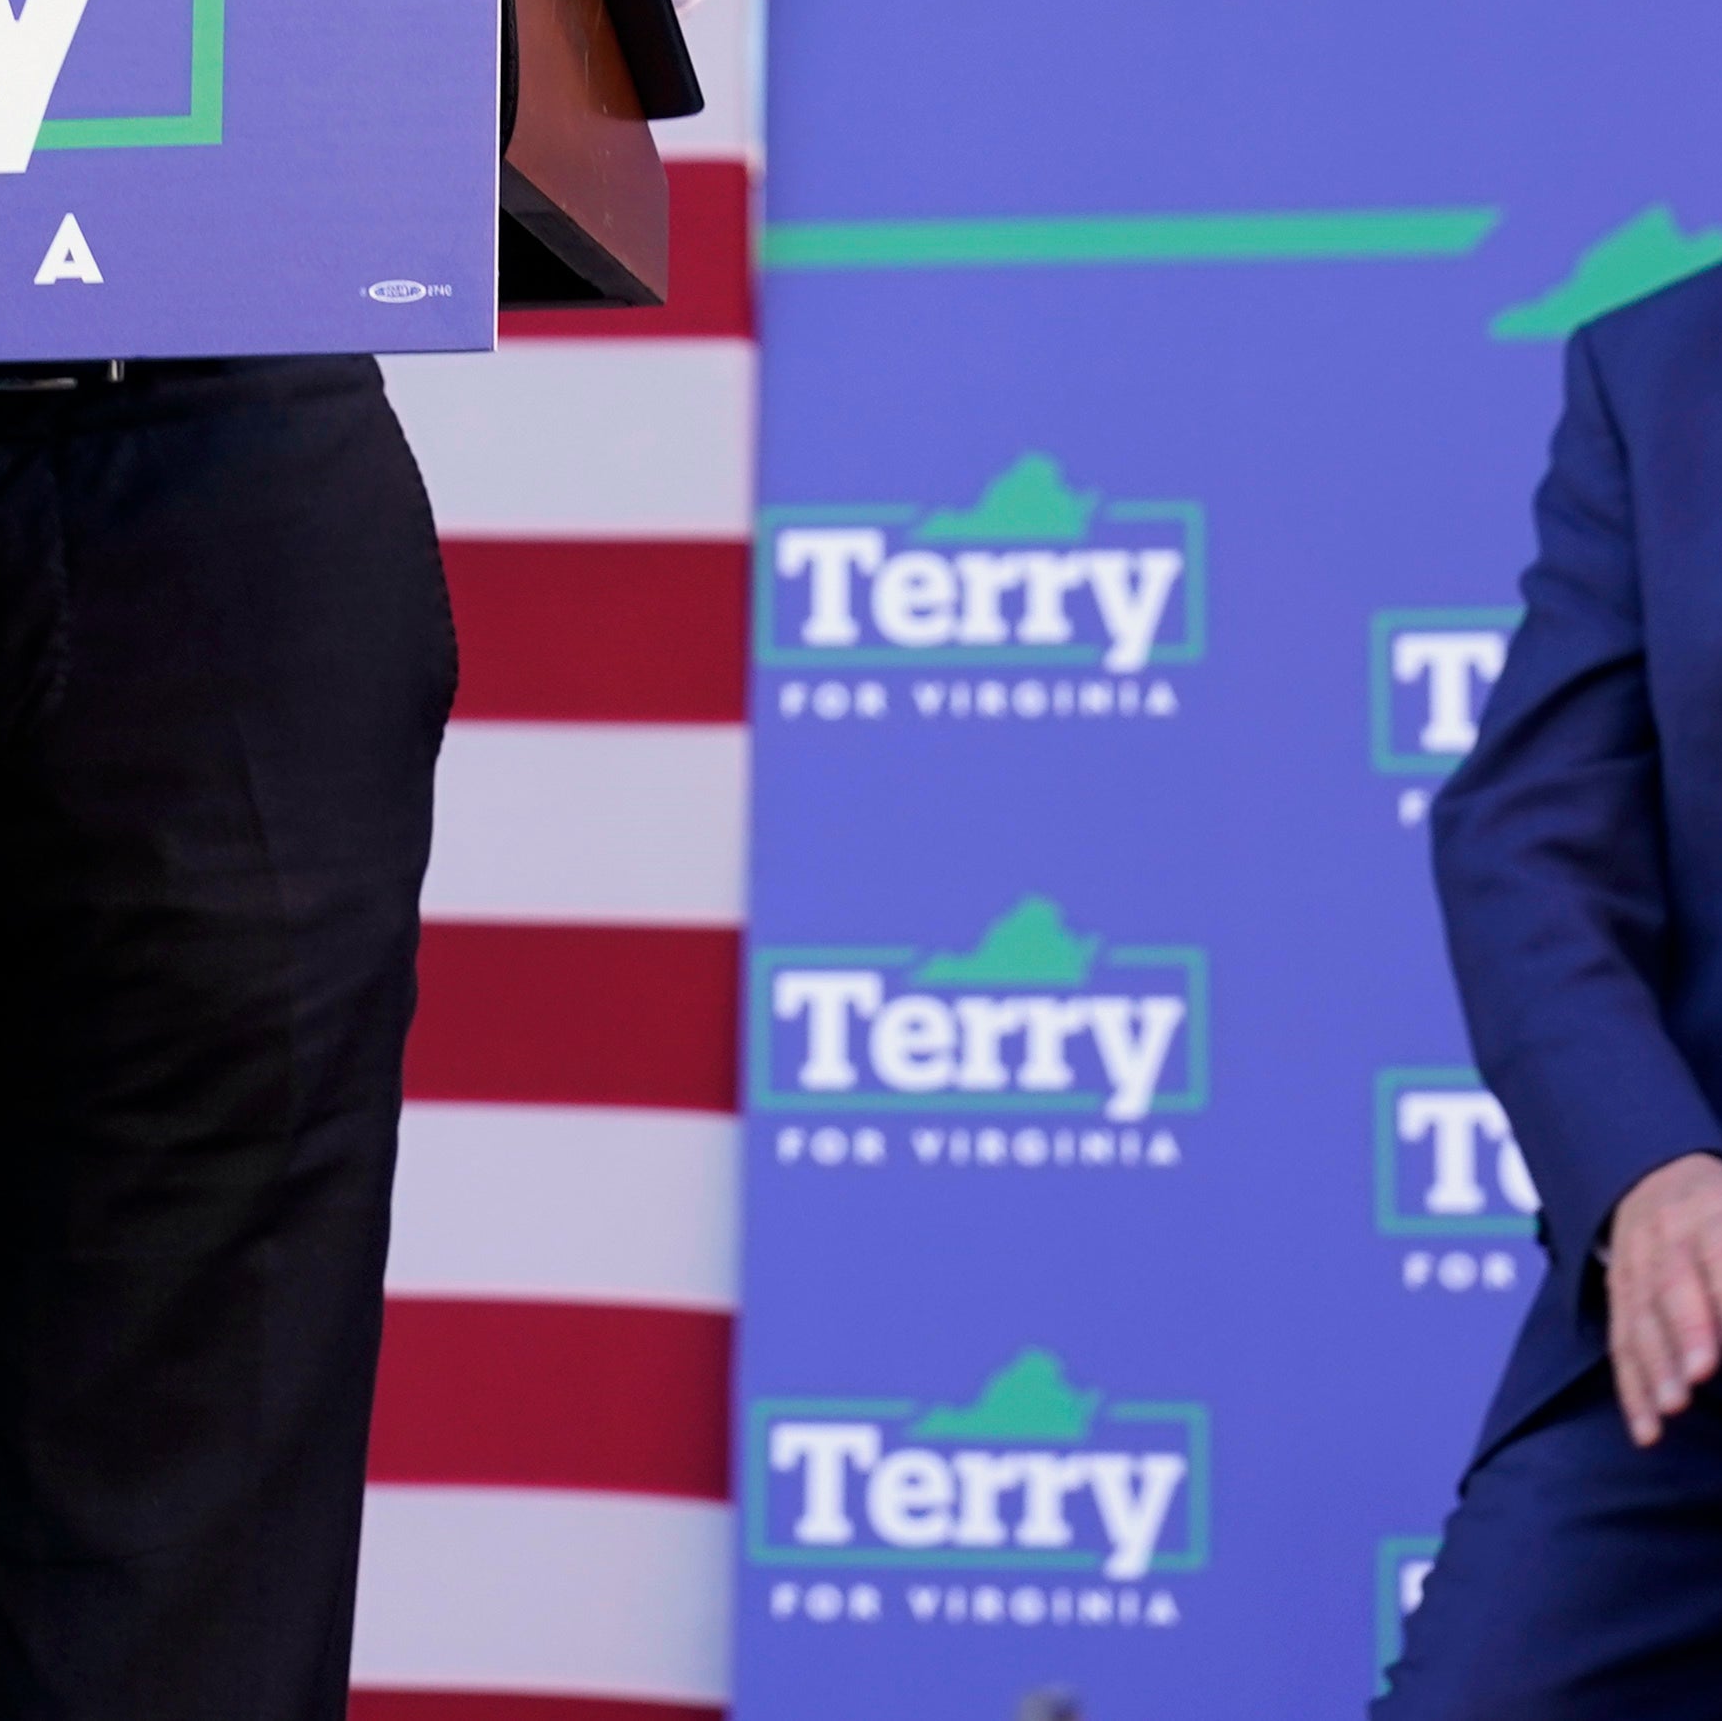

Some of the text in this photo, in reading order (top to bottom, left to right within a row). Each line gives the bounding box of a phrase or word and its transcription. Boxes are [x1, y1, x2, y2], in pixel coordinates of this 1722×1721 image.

[776, 527, 1183, 673] Terry
[779, 680, 1178, 719] FOR VIRGINIA
[774, 969, 1186, 1121] Terry
[777, 1125, 1180, 1167] FOR VIRGINIA
[1402, 1250, 1518, 1294] FOR
[769, 1422, 1187, 1580] Terry
[769, 1581, 1181, 1628] FOR VIRGINIA
